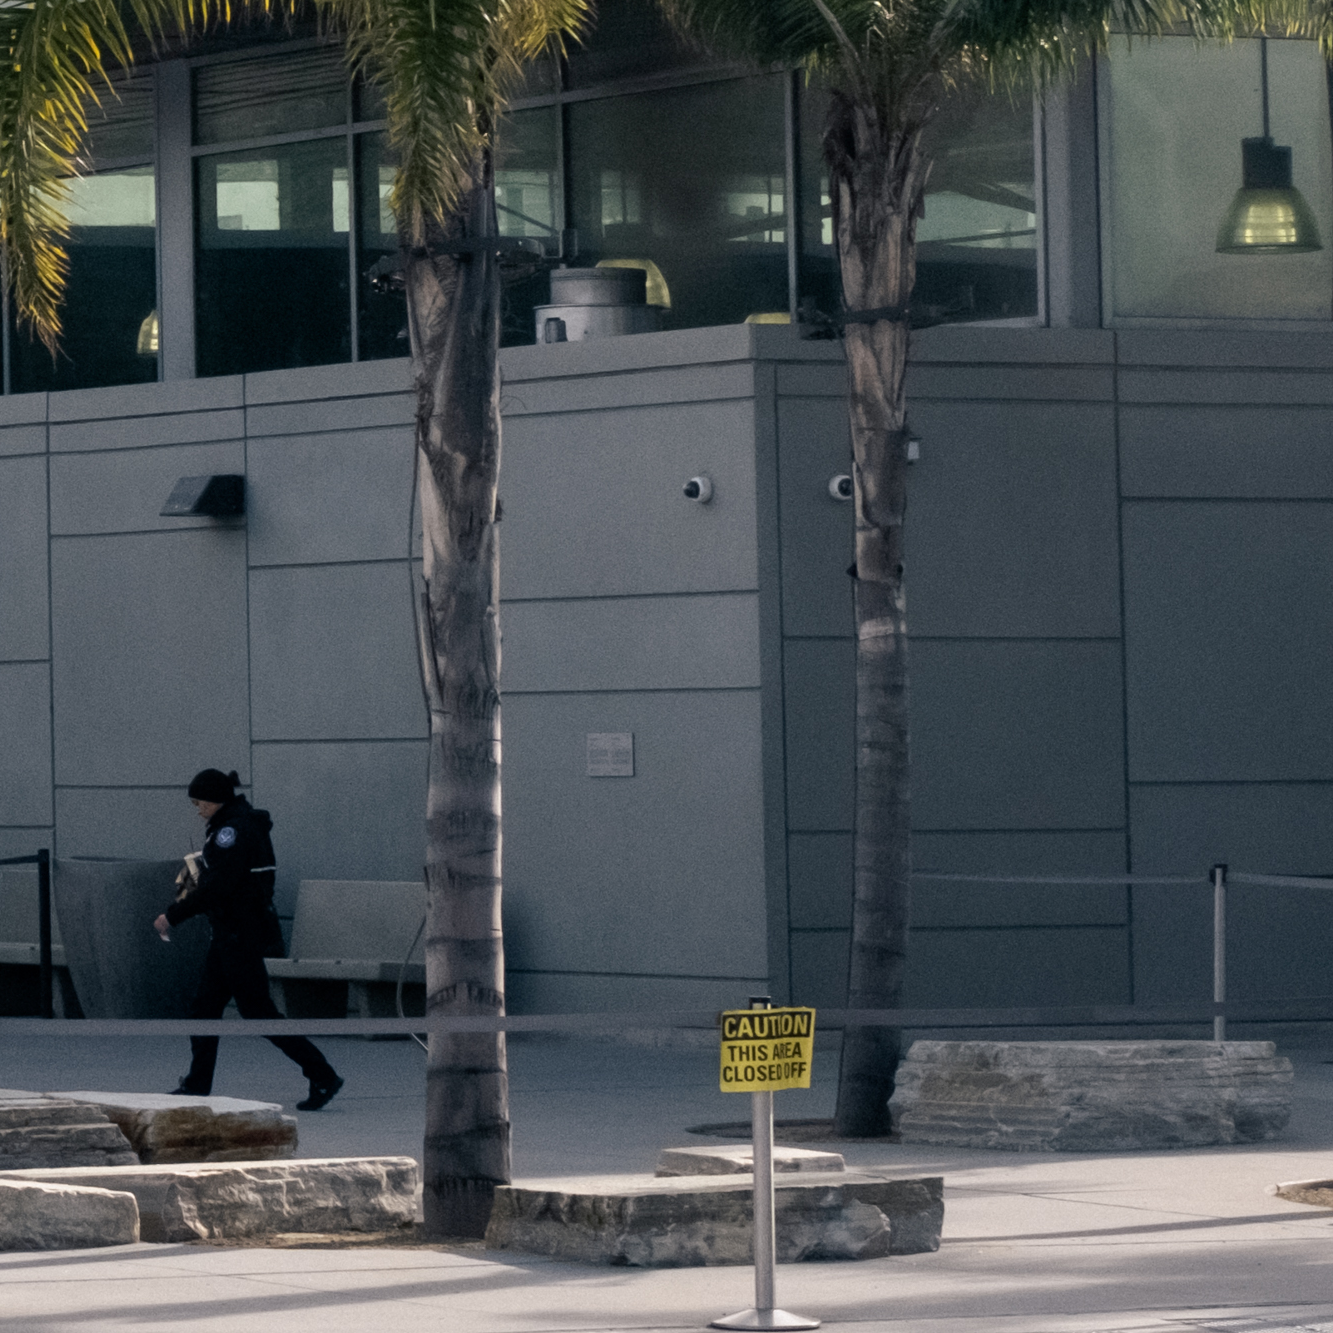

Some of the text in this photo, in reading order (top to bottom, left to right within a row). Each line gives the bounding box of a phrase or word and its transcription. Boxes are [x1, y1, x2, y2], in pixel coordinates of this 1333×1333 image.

[724, 1014, 808, 1038] CAUTION
[727, 1042, 802, 1062] THIS AREA
[723, 1062, 807, 1082] CLOSED OFF
